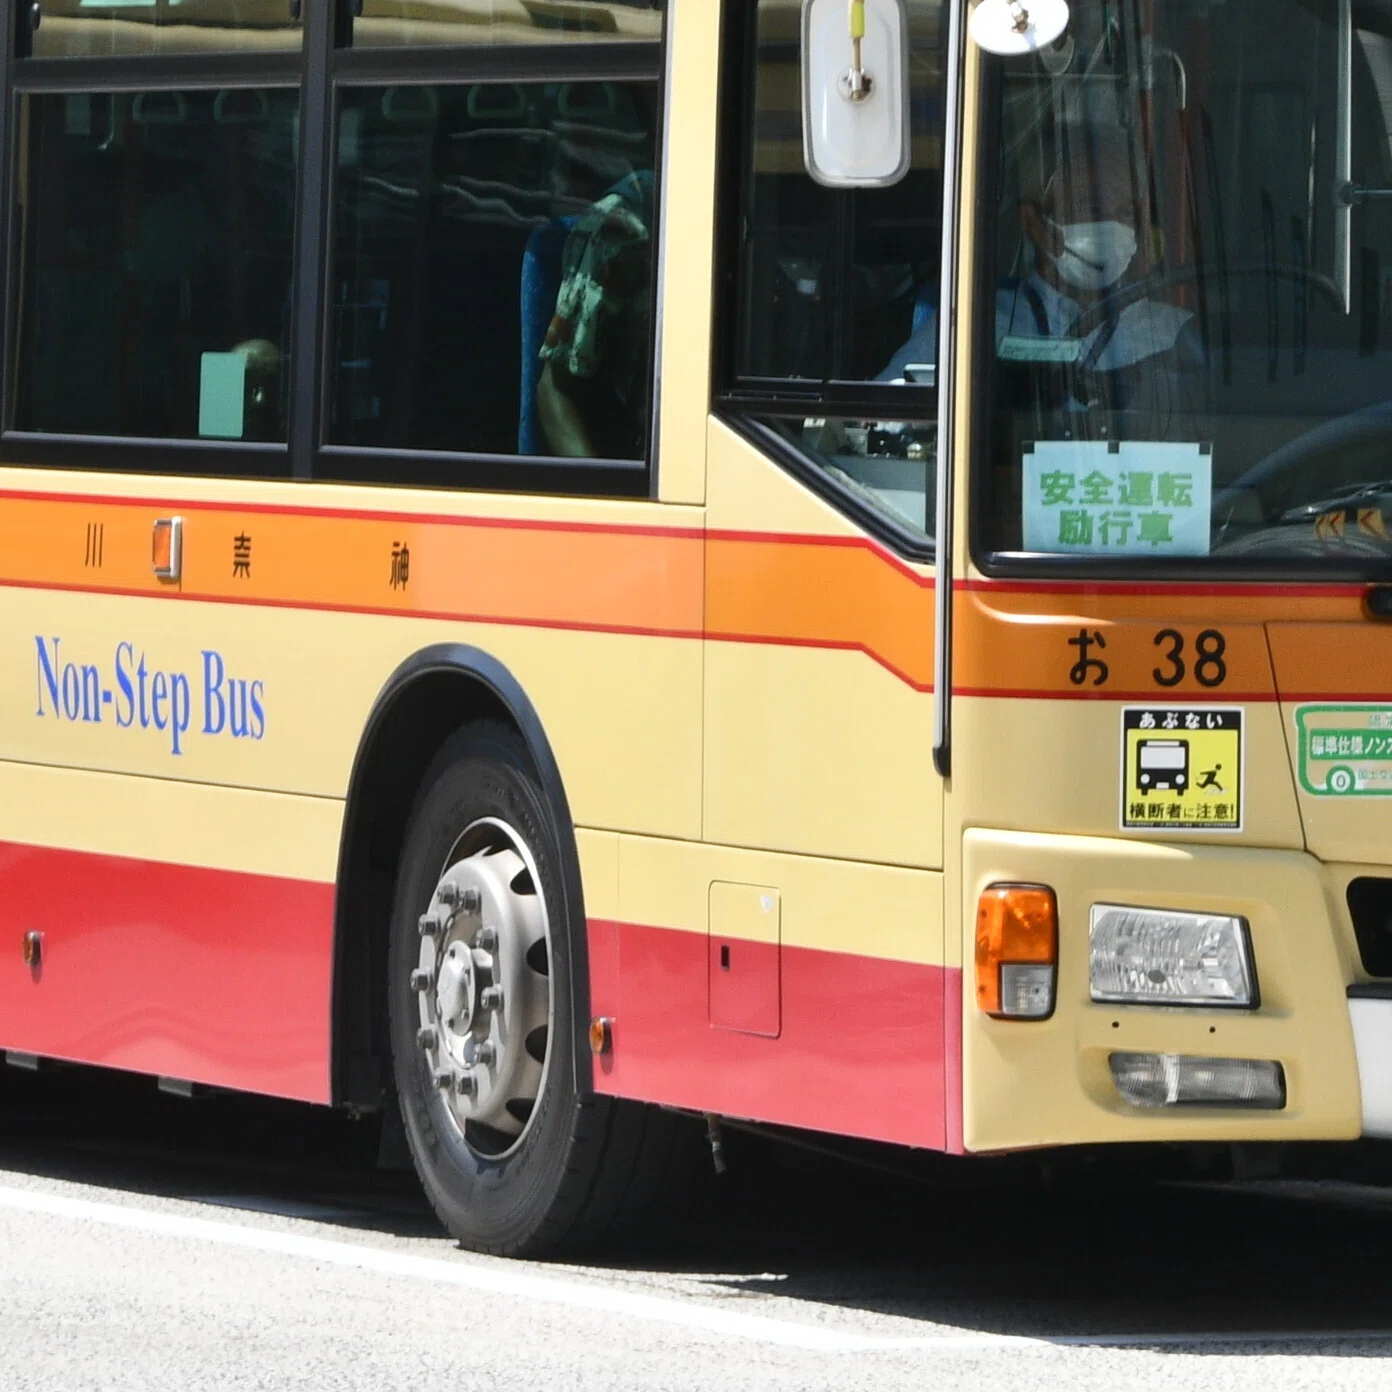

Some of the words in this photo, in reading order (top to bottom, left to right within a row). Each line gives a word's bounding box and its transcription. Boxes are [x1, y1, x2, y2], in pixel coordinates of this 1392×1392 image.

[1039, 469, 1193, 507] 安全運転
[1057, 509, 1174, 546] 励行車
[1067, 628, 1109, 686] お
[1152, 628, 1227, 688] 38
[34, 635, 190, 755] Non-Step
[200, 649, 265, 740] Bus
[1139, 711, 1224, 730] あぶない
